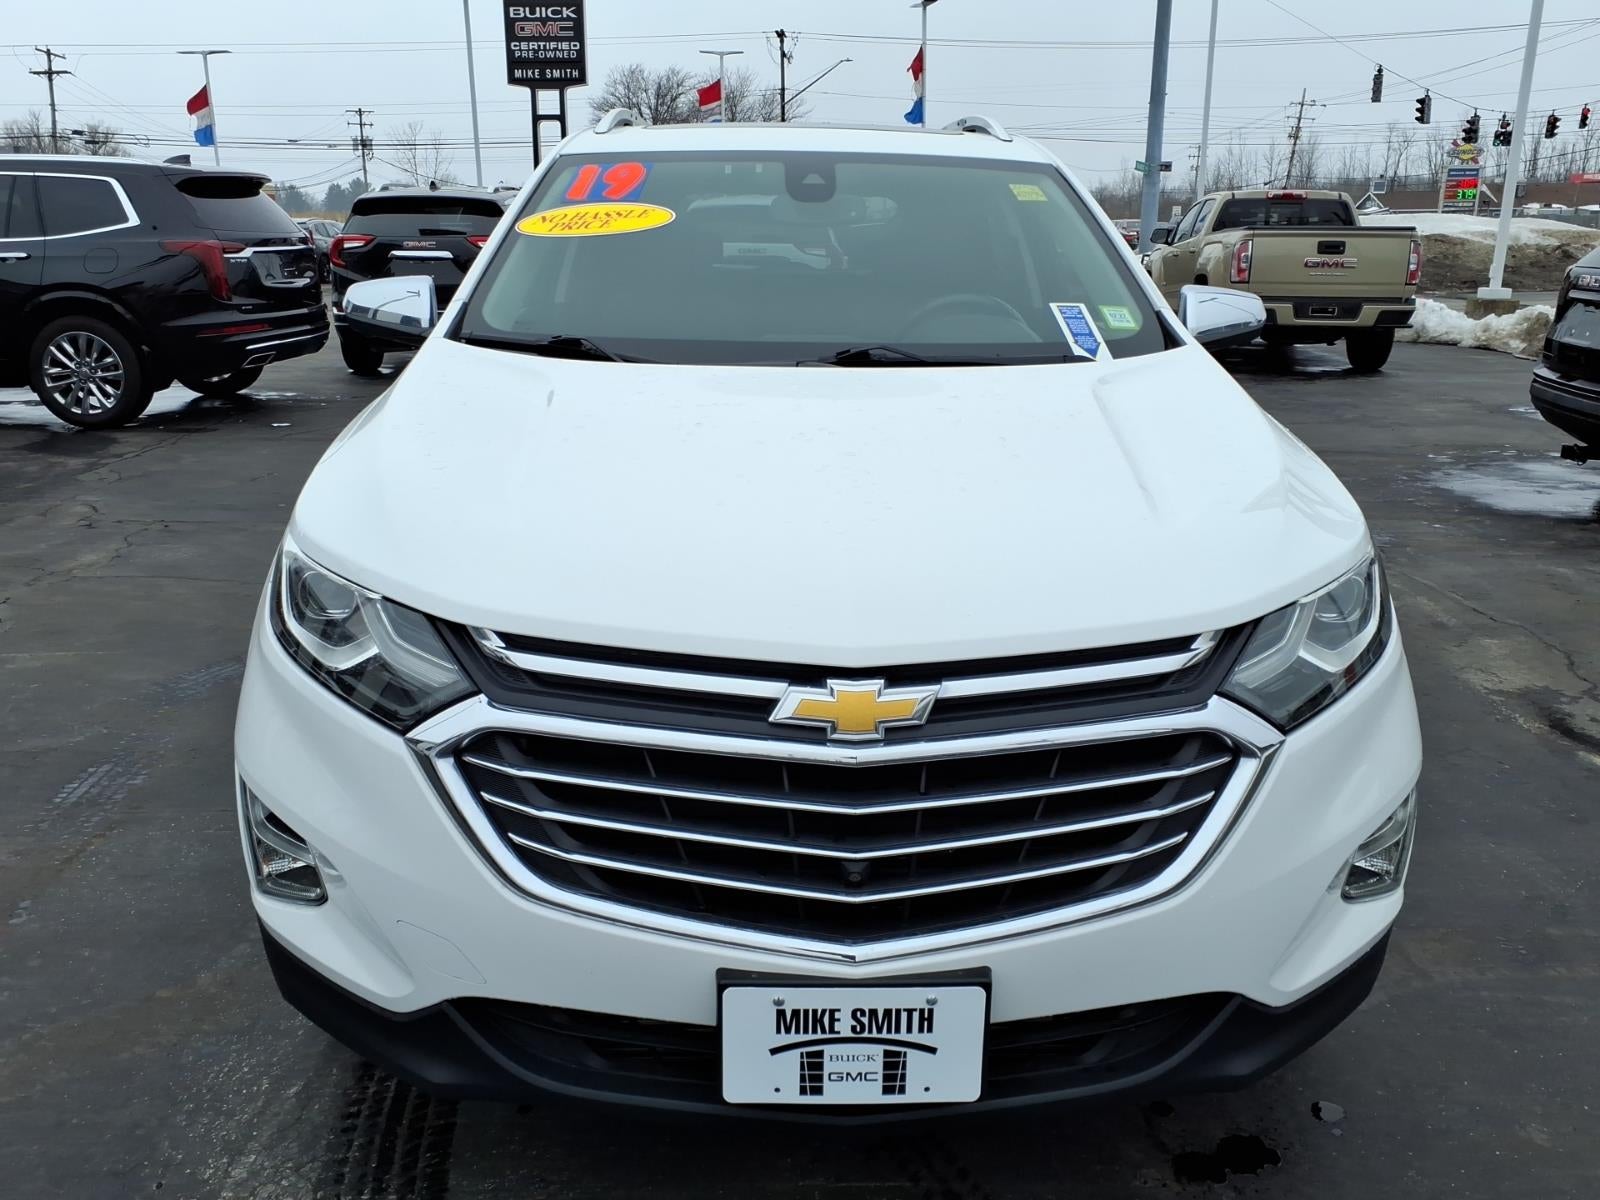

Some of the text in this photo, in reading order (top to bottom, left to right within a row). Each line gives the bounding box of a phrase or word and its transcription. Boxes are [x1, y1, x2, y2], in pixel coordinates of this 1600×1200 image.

[509, 7, 578, 18] BUICK
[514, 21, 575, 37] GMC
[510, 41, 580, 50] CERTIFIED
[515, 50, 577, 58] PRE-OWNED
[514, 69, 579, 79] MIKE SMITH
[565, 161, 647, 200] 19
[534, 208, 651, 225] NO HASSLE
[548, 219, 612, 232] PRICE
[402, 241, 437, 249] GMC
[1304, 257, 1358, 269] GMC
[775, 1007, 935, 1035] MIKE SMITH
[828, 1054, 877, 1062] BUICK
[827, 1071, 879, 1082] GMC
